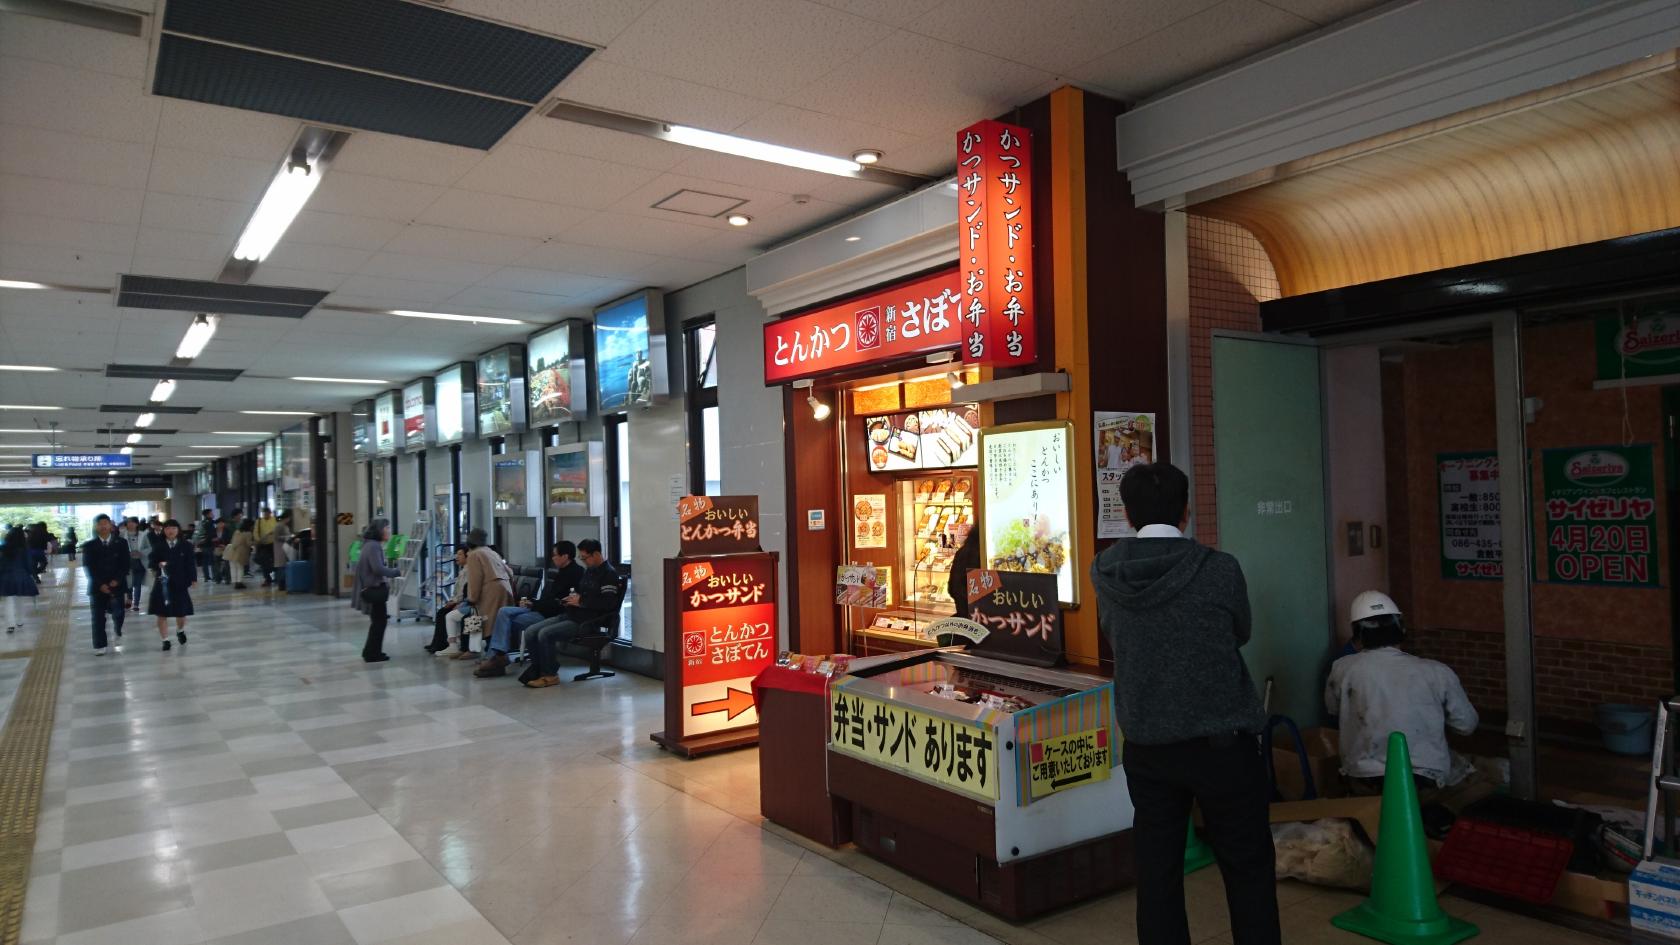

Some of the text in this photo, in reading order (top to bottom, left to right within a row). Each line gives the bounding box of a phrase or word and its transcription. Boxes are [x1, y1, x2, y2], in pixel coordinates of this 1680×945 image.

[962, 131, 986, 358] かつサンド・お弁当
[1000, 129, 1025, 357] かつサンド・お弁当
[773, 322, 851, 366] とんかつ
[885, 305, 897, 342] 新宿
[1041, 446, 1050, 484] とんかつ
[1052, 432, 1061, 473] おいしい
[681, 497, 749, 521] 名物 おいしい
[1257, 500, 1292, 515] 非常出口
[1547, 497, 1654, 521] サイゼリヤ
[681, 520, 758, 541] とんかつ弁当
[1550, 524, 1650, 553] 4月20日
[682, 566, 753, 588] 名物 おいしい
[1555, 554, 1649, 582] OPEN
[690, 583, 764, 608] かつサンド
[968, 572, 1044, 609] 名物 おいしい
[710, 622, 770, 643] とんかつ
[971, 608, 1056, 641] かつサンド
[711, 642, 769, 664] さぼてん
[834, 692, 993, 789] 弁当・サンド あります
[1045, 734, 1095, 760] ケースの中に
[1032, 749, 1108, 781] ご用意いたしております
